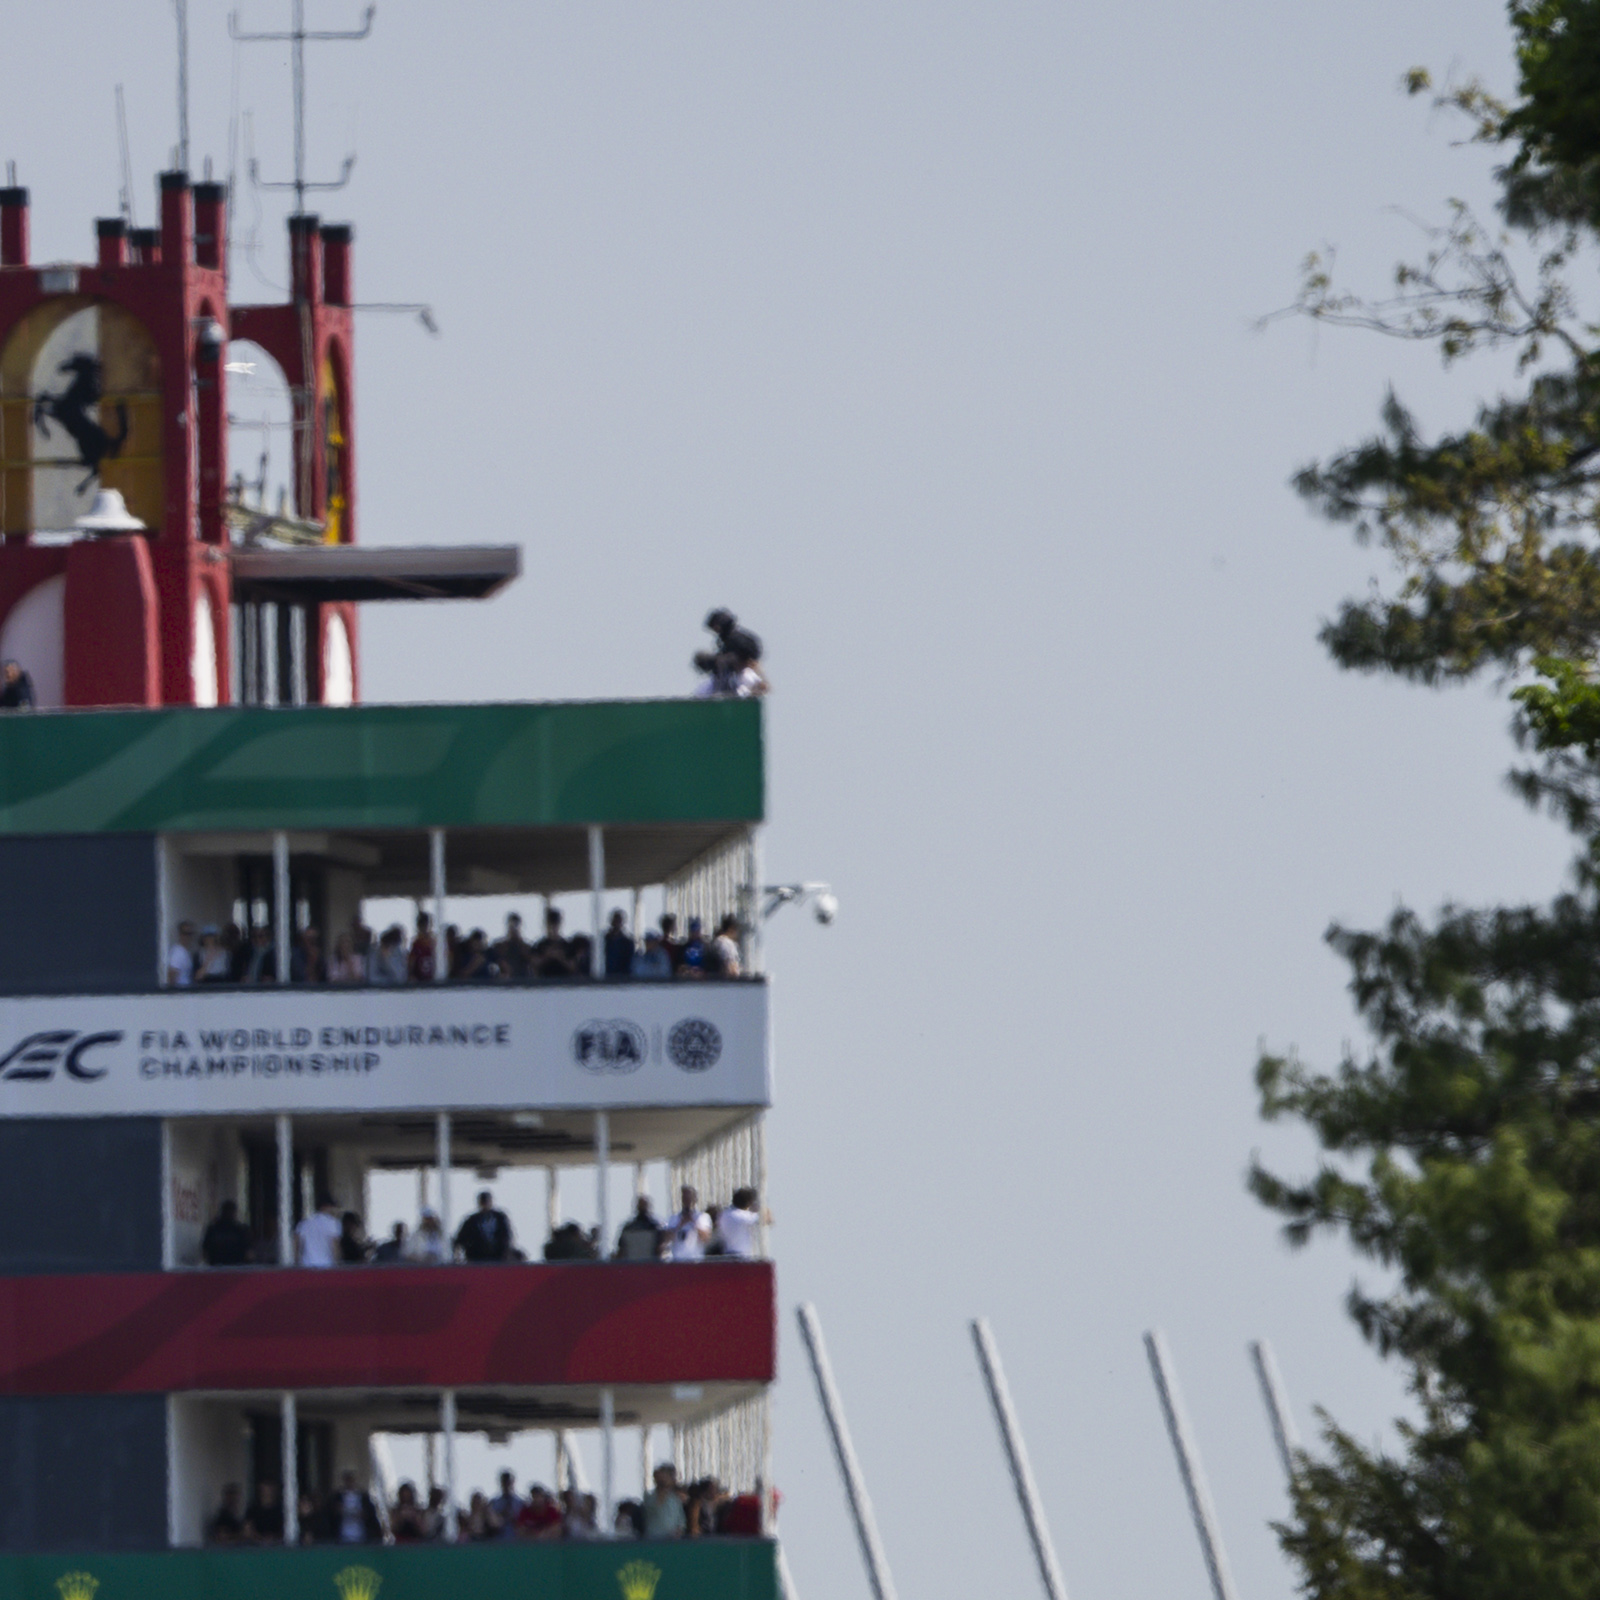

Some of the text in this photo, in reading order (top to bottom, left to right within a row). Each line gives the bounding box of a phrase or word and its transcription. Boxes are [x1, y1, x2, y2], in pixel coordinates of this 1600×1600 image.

[139, 1023, 512, 1051] FIA WORLD ENDURANCE
[138, 1053, 382, 1080] CHAMPIONSHIP
